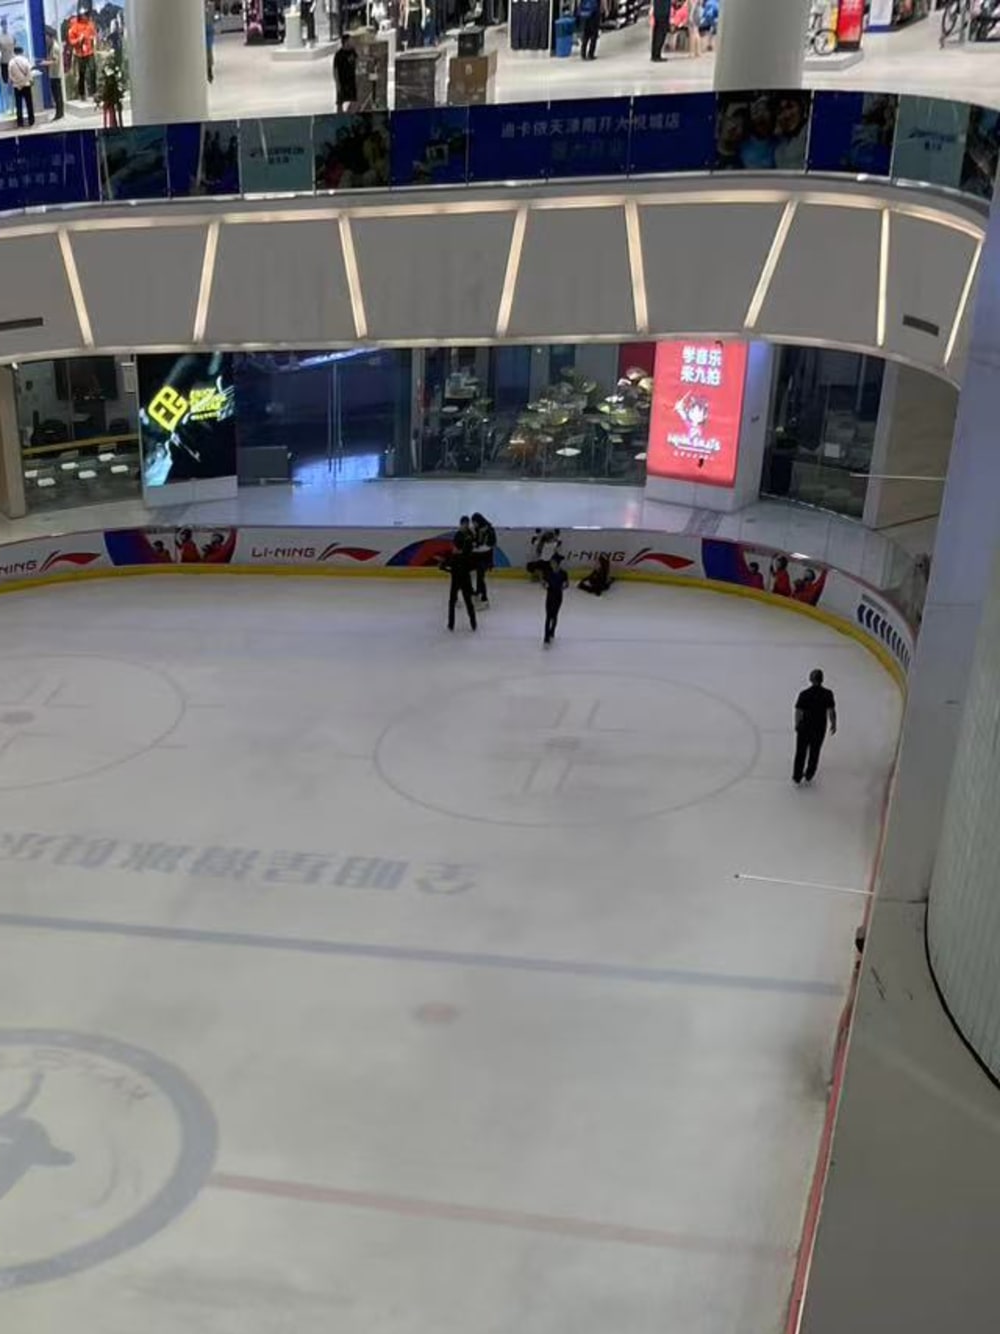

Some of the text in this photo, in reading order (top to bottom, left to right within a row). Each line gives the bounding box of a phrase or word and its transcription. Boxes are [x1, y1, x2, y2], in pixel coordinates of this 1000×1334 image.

[682, 346, 722, 366] 学音乐
[680, 365, 721, 385] 来九拍
[252, 547, 316, 559] LI-NING
[566, 551, 626, 562] I-NING
